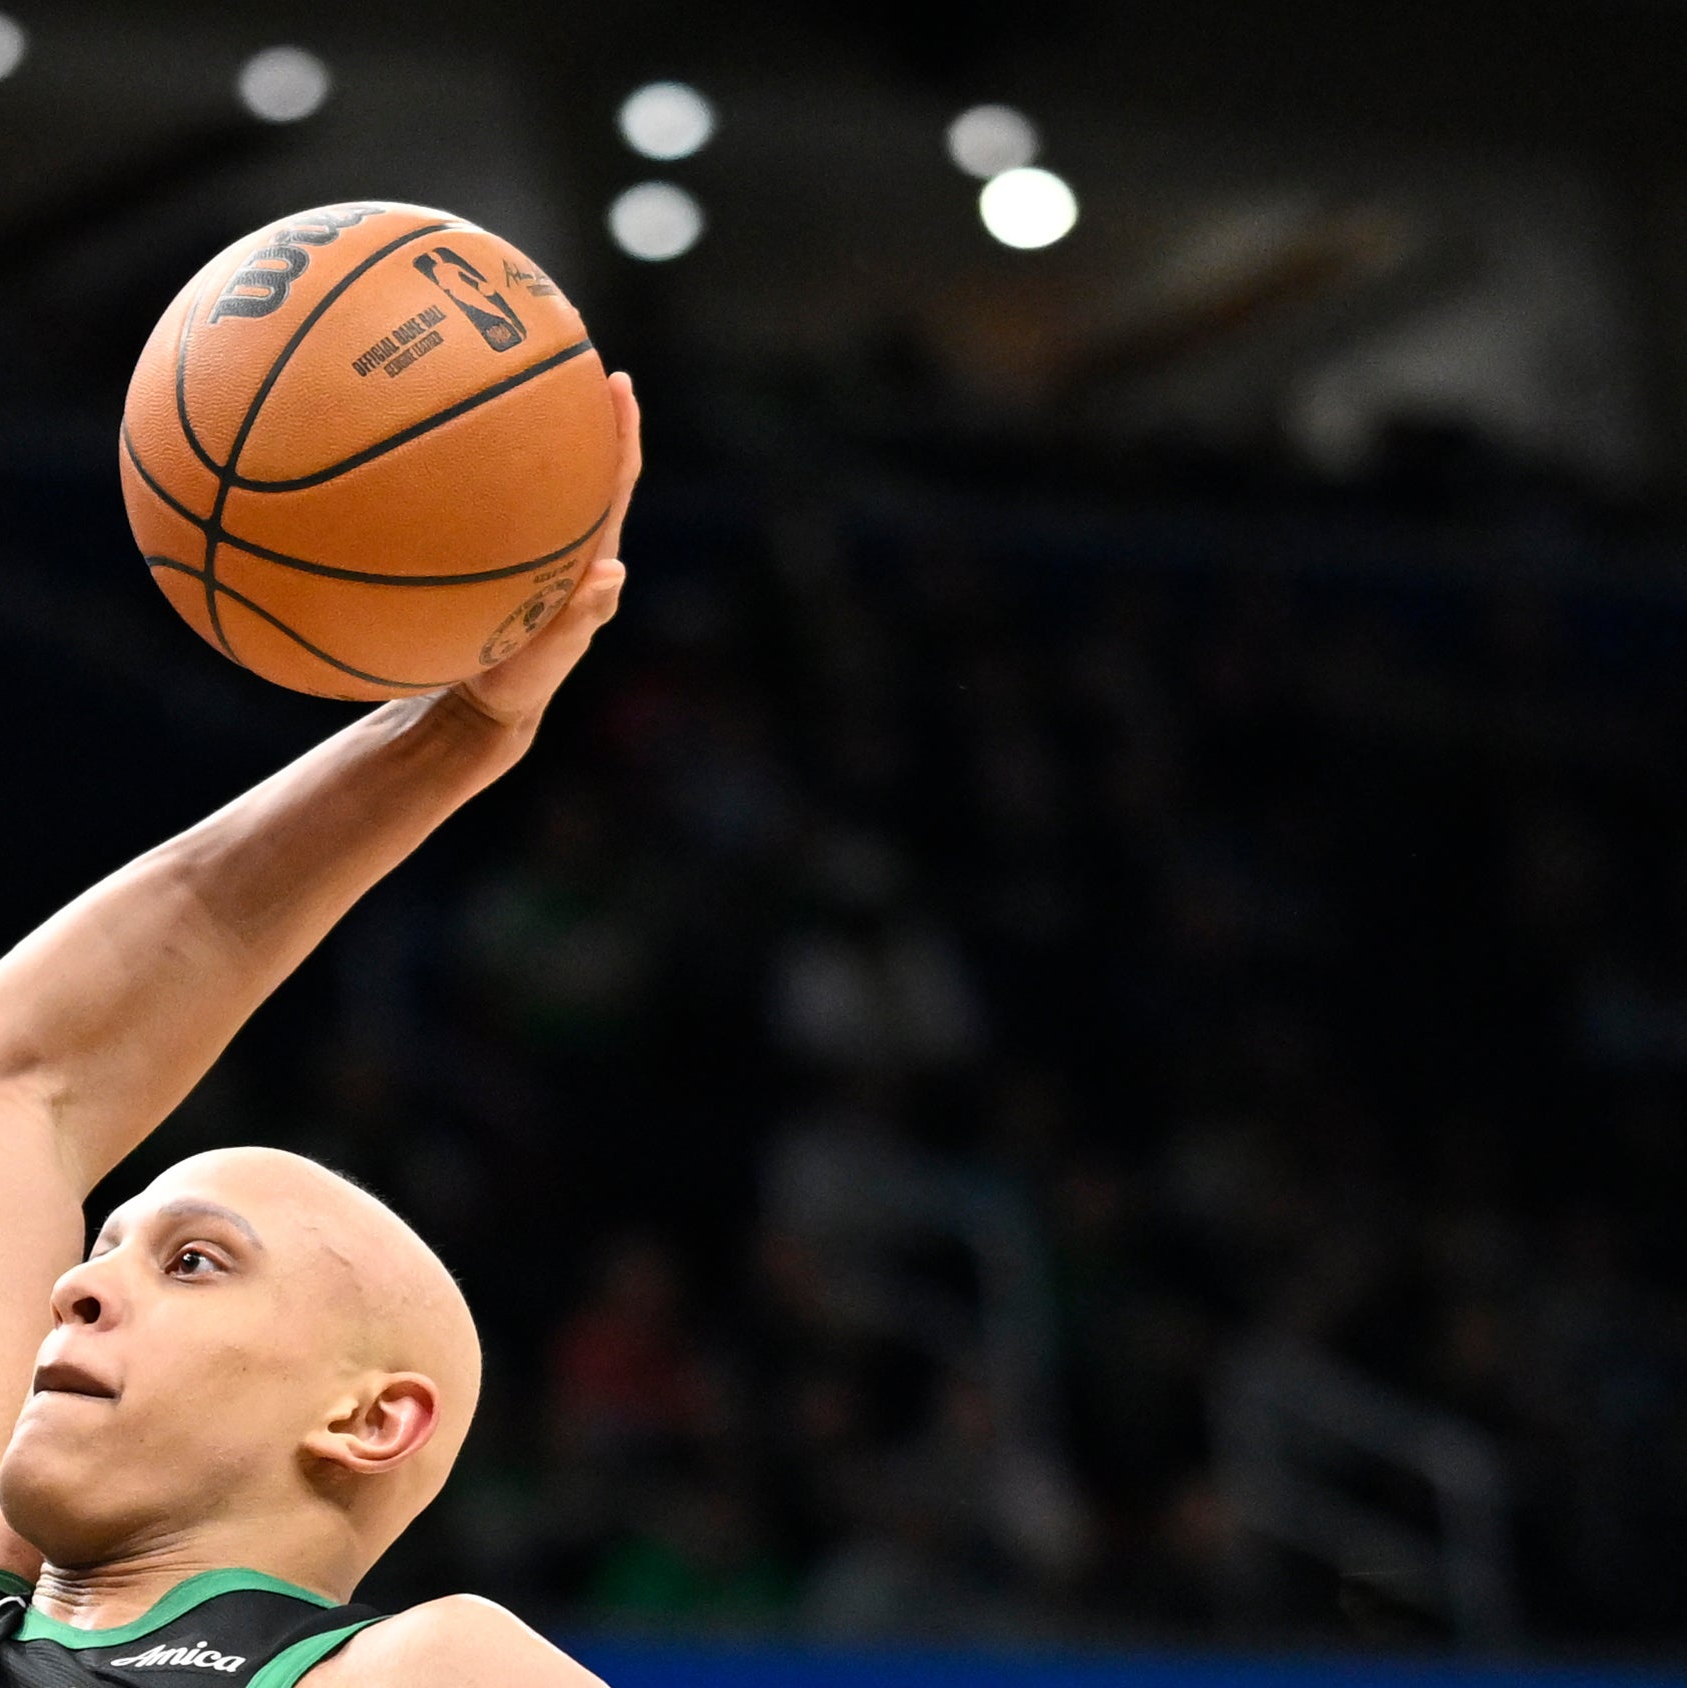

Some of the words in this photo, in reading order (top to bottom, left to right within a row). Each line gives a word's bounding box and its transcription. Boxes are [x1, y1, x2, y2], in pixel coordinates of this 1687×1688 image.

[352, 337, 400, 377] OFFICIAL
[392, 317, 426, 345] GAME
[417, 304, 447, 329] BALL
[110, 1640, 247, 1673] Amica
